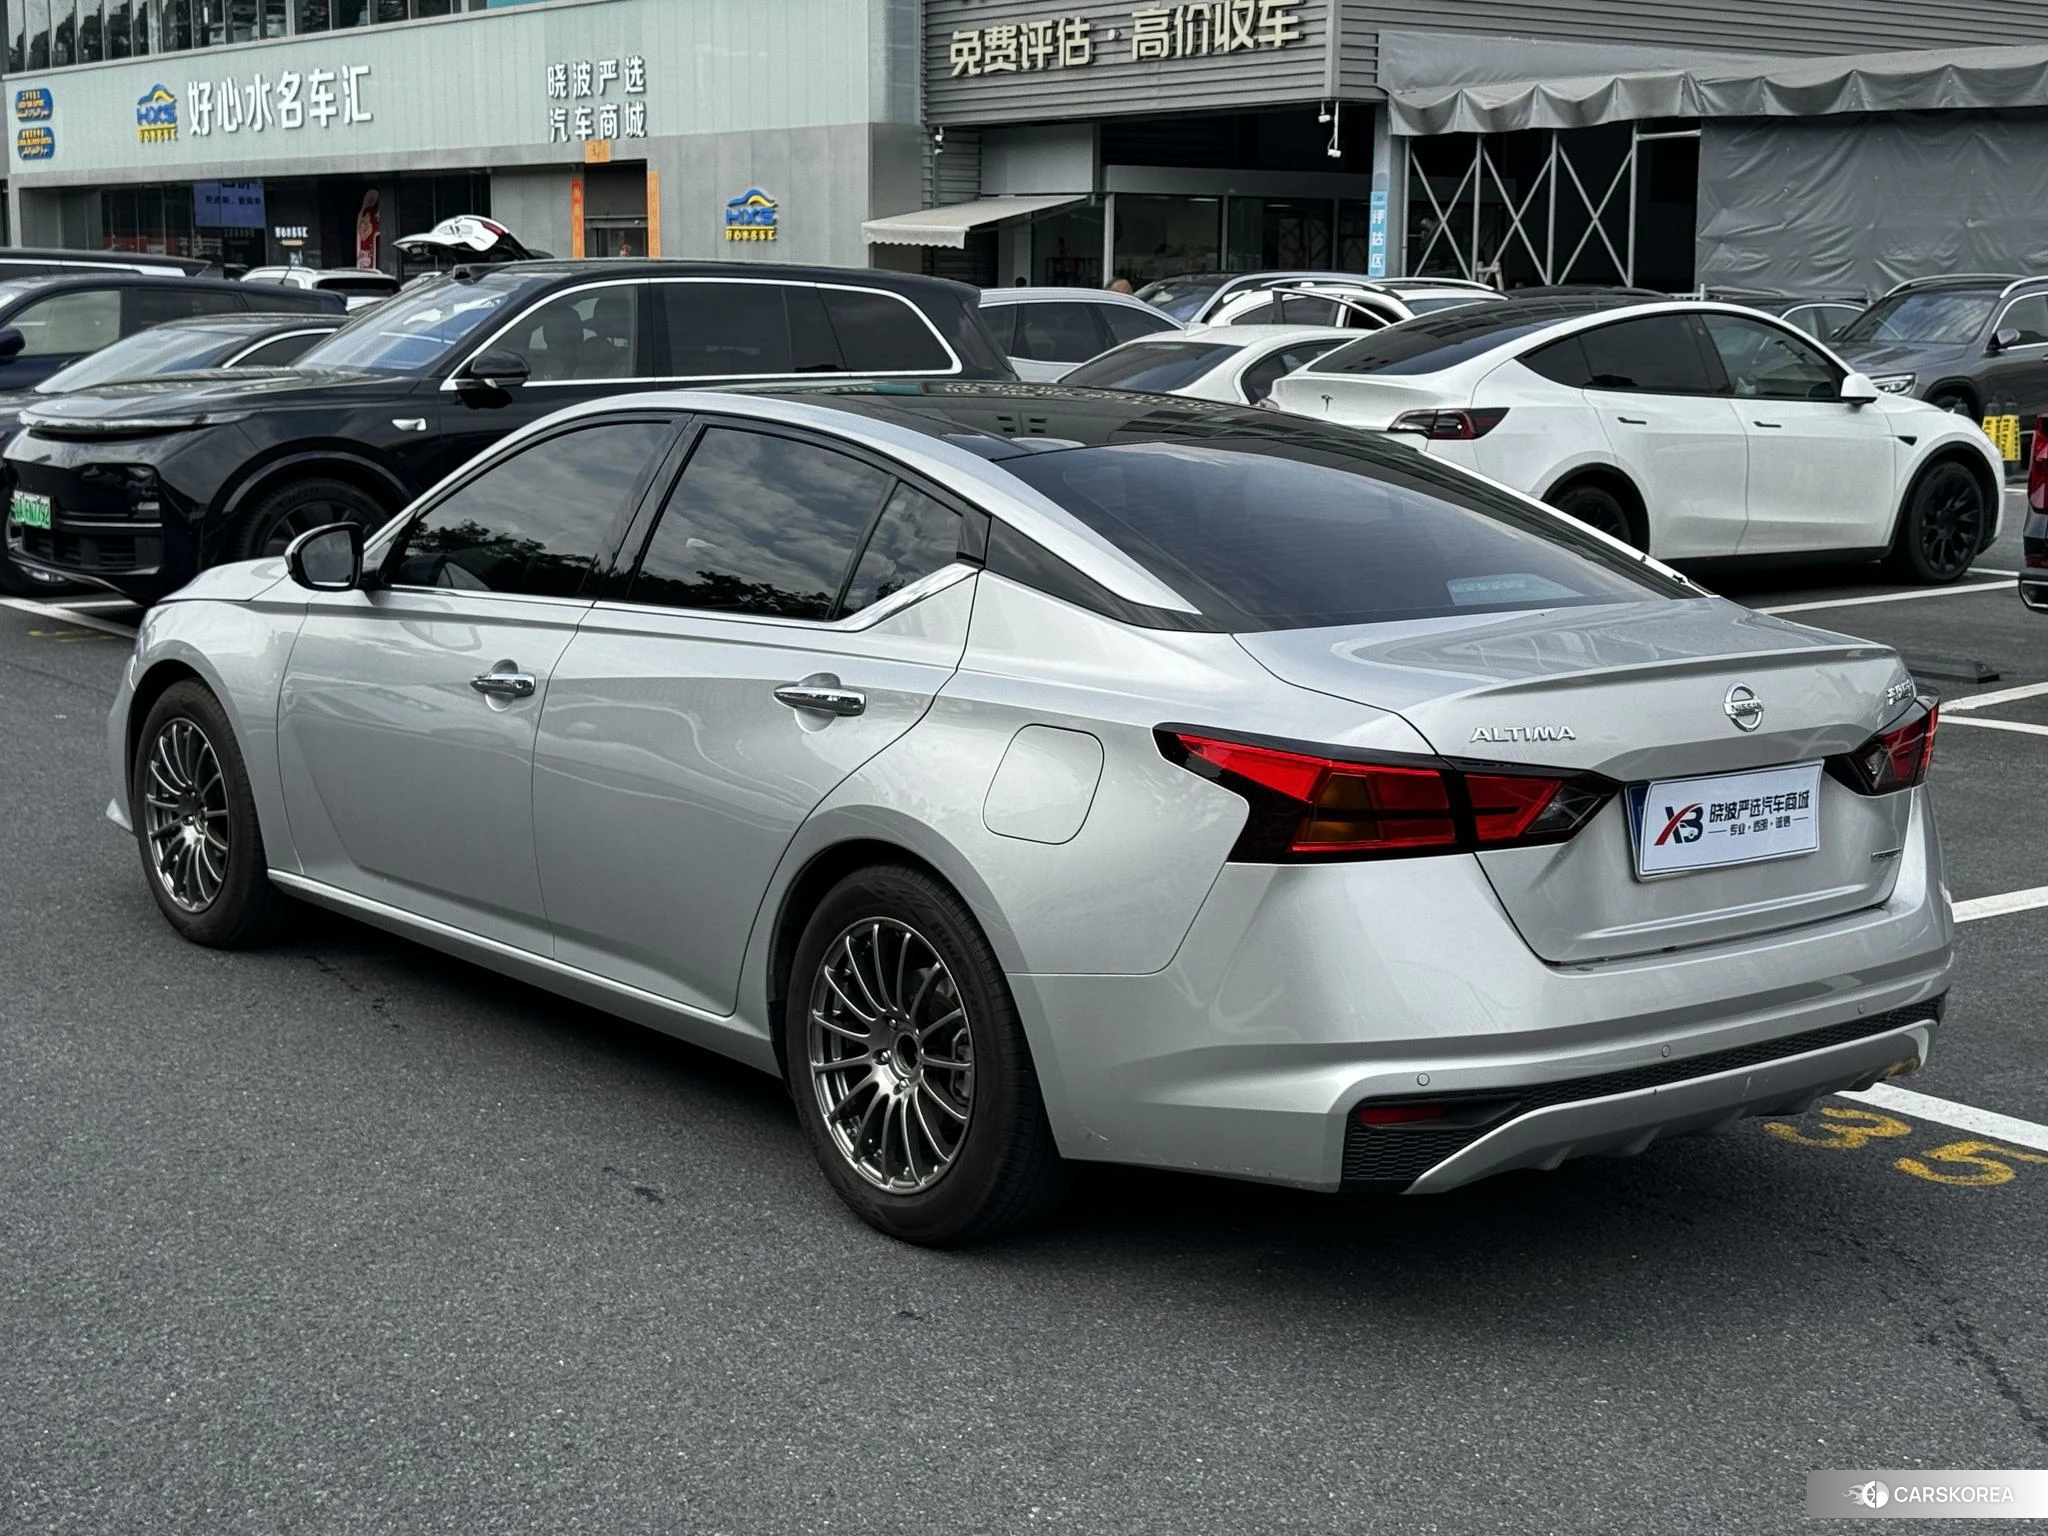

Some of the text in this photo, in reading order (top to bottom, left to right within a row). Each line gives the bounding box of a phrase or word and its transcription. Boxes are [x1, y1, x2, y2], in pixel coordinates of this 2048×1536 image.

[949, 0, 1301, 77] 免费评估·高价收车
[547, 56, 646, 98] 晓波严选
[187, 64, 374, 136] 好心水名车汇
[549, 102, 648, 142] 汽车商城
[1371, 208, 1385, 268] 评估区
[1470, 725, 1576, 743] ALTIMA
[1709, 790, 1810, 823] 晓波严选汽车商城
